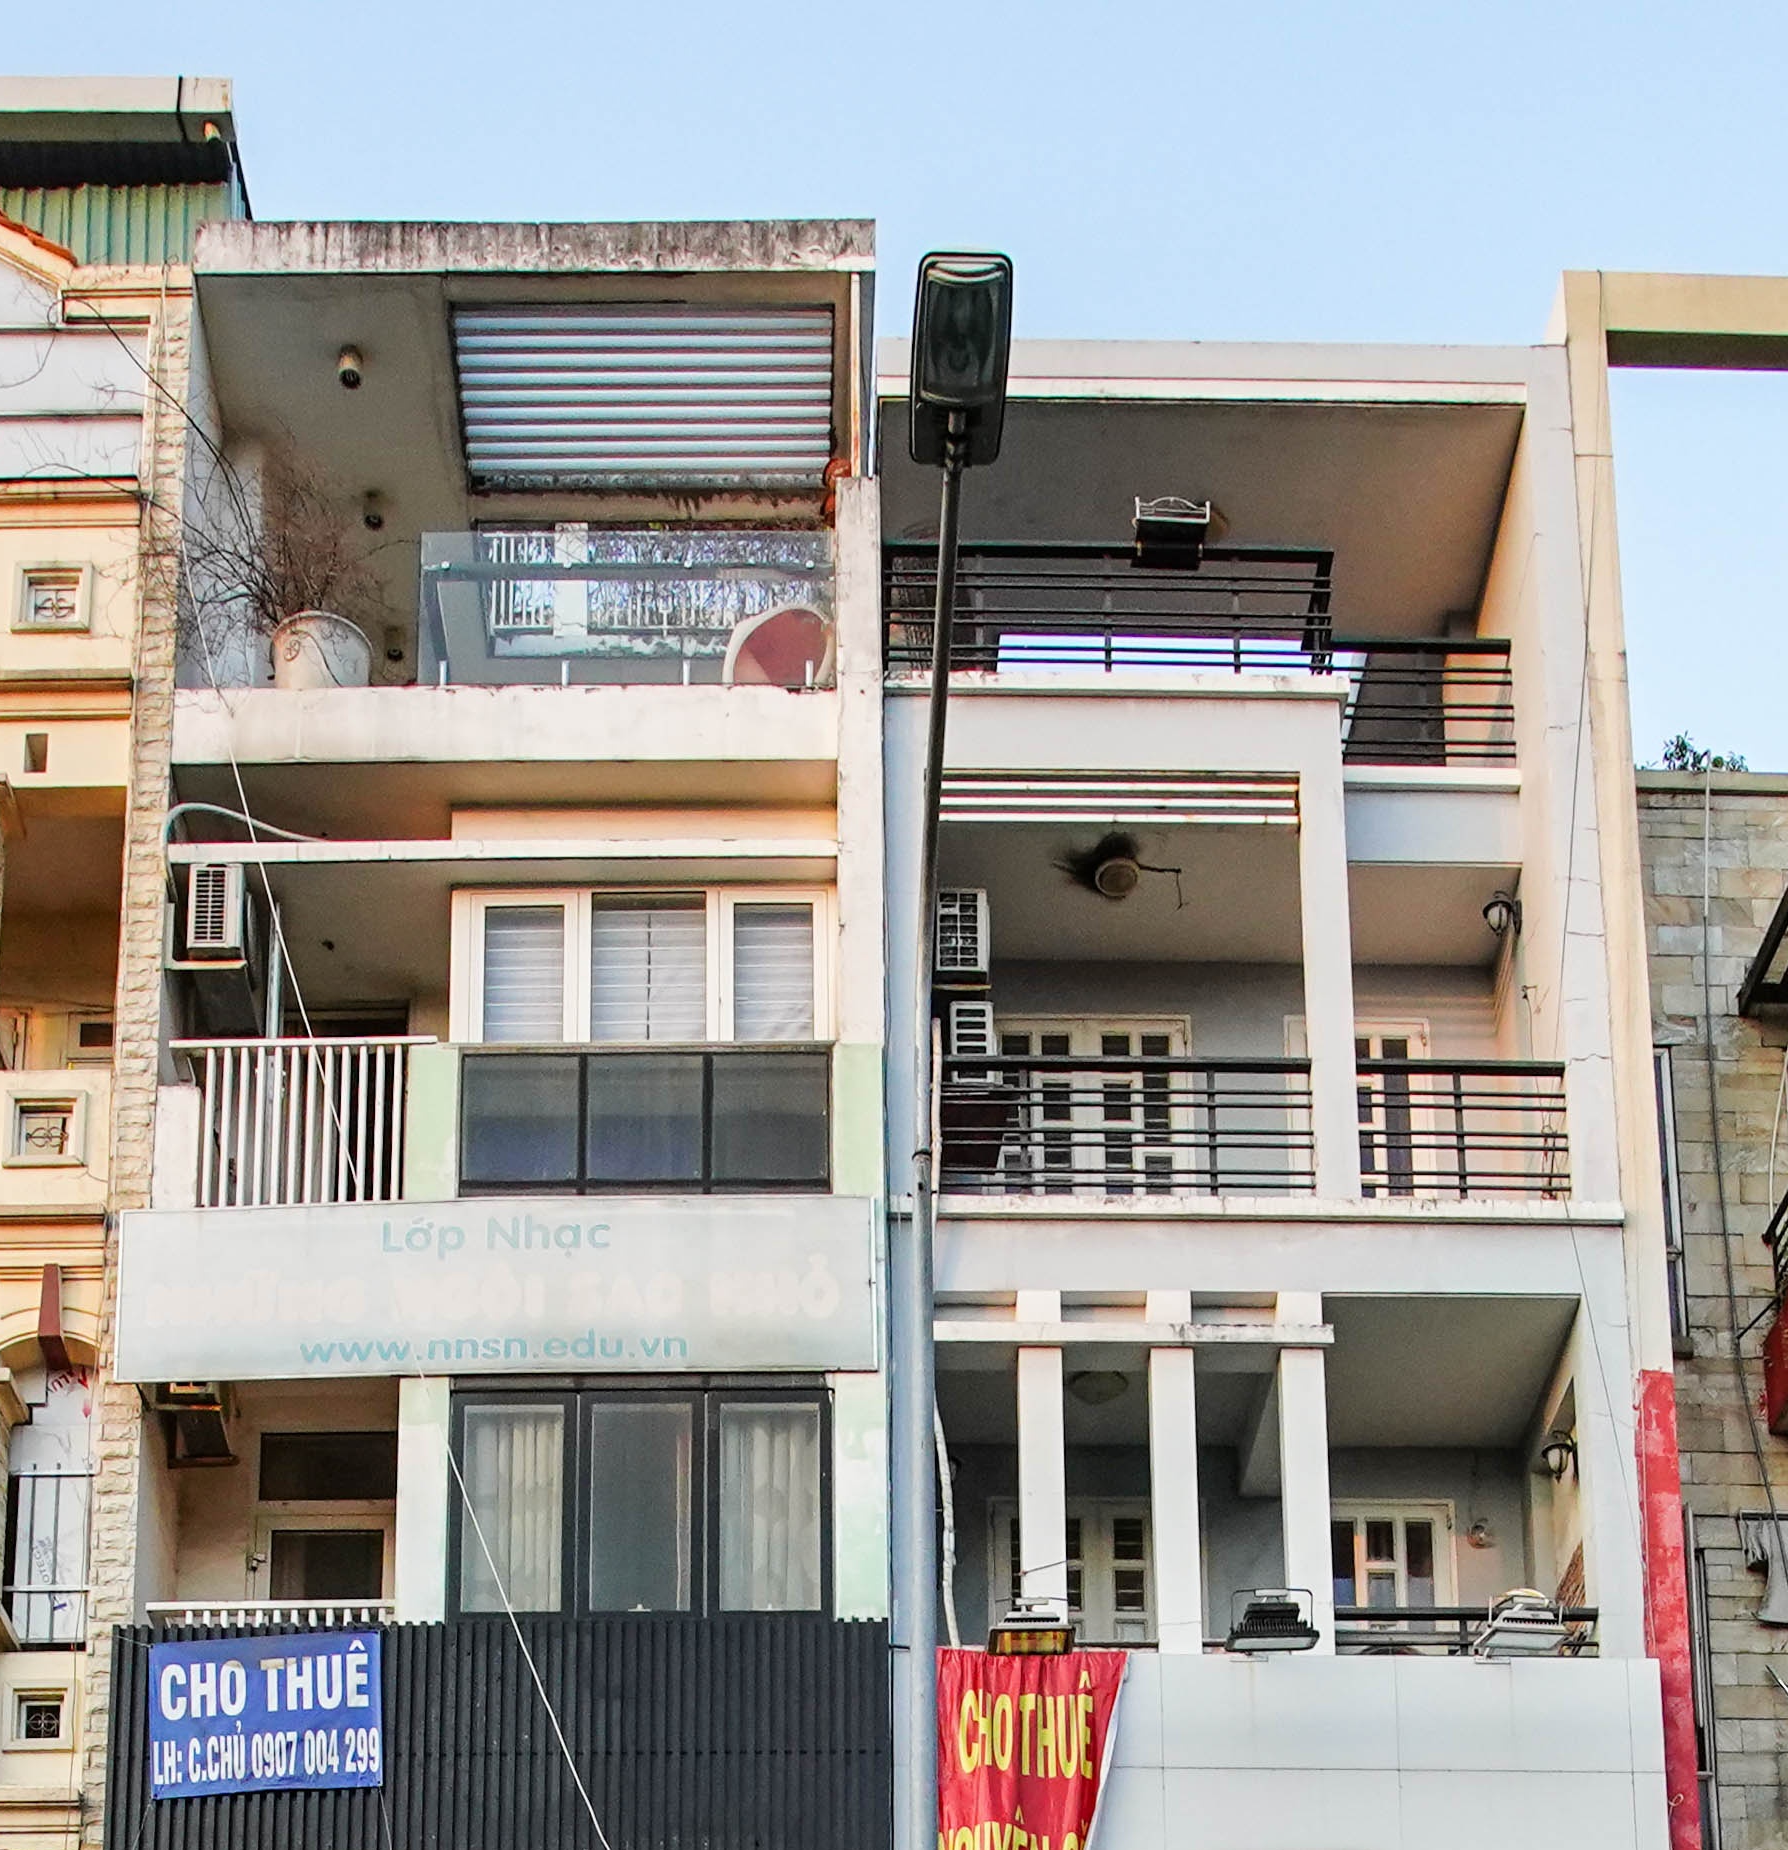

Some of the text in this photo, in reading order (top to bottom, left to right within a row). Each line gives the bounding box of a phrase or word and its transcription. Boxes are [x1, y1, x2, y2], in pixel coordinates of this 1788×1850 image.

[382, 1215, 612, 1260] Lớp Nhạc
[299, 1329, 689, 1364] www.nnsn.edu.vn
[161, 1640, 370, 1721] CHO THUÊ
[958, 1671, 1093, 1780] CHO THUÊ
[153, 1741, 183, 1785] LH:
[251, 1731, 298, 1779] 0907
[303, 1729, 340, 1775] 004
[344, 1727, 380, 1774] 299
